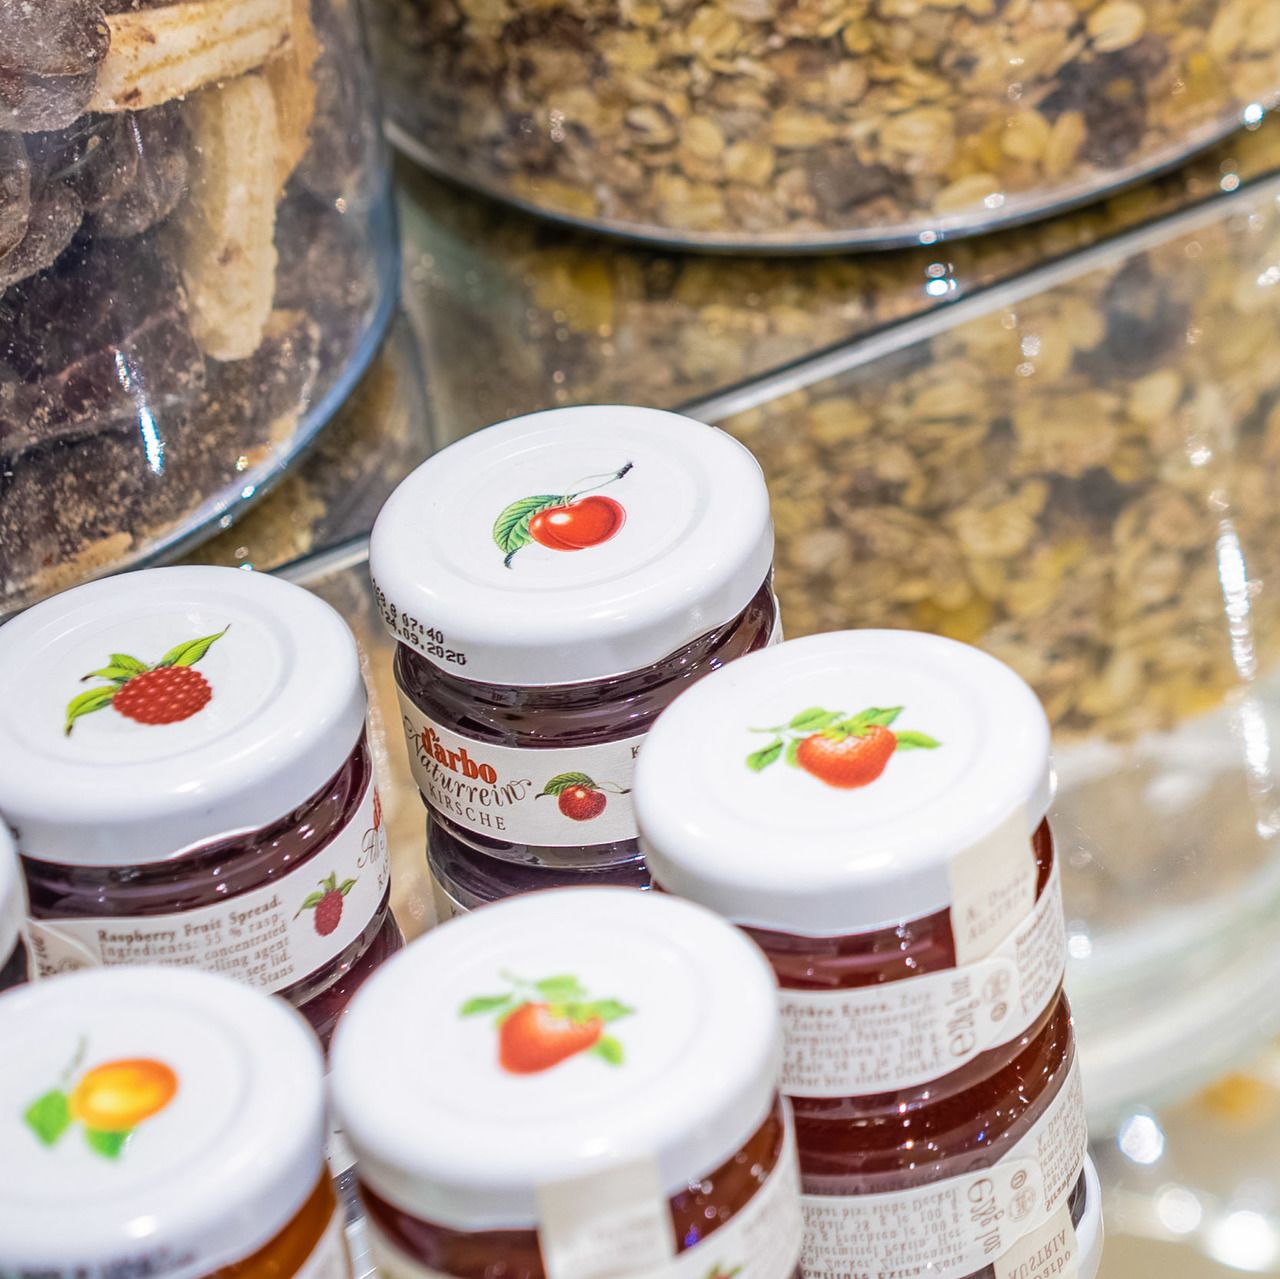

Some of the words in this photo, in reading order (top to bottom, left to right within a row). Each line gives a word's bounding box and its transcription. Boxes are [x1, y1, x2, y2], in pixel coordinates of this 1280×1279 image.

[385, 611, 467, 666] 24.09.2020
[401, 613, 444, 644] 07:40
[428, 782, 506, 831] KIRSCHE
[97, 929, 176, 945] Raspberry
[184, 919, 222, 937] Fruit
[228, 895, 283, 926] Spread.
[100, 941, 199, 960] Ingredients:
[204, 921, 288, 962] concentrated
[254, 935, 290, 961] agent
[259, 963, 295, 987] Stans
[270, 951, 291, 968] lid.
